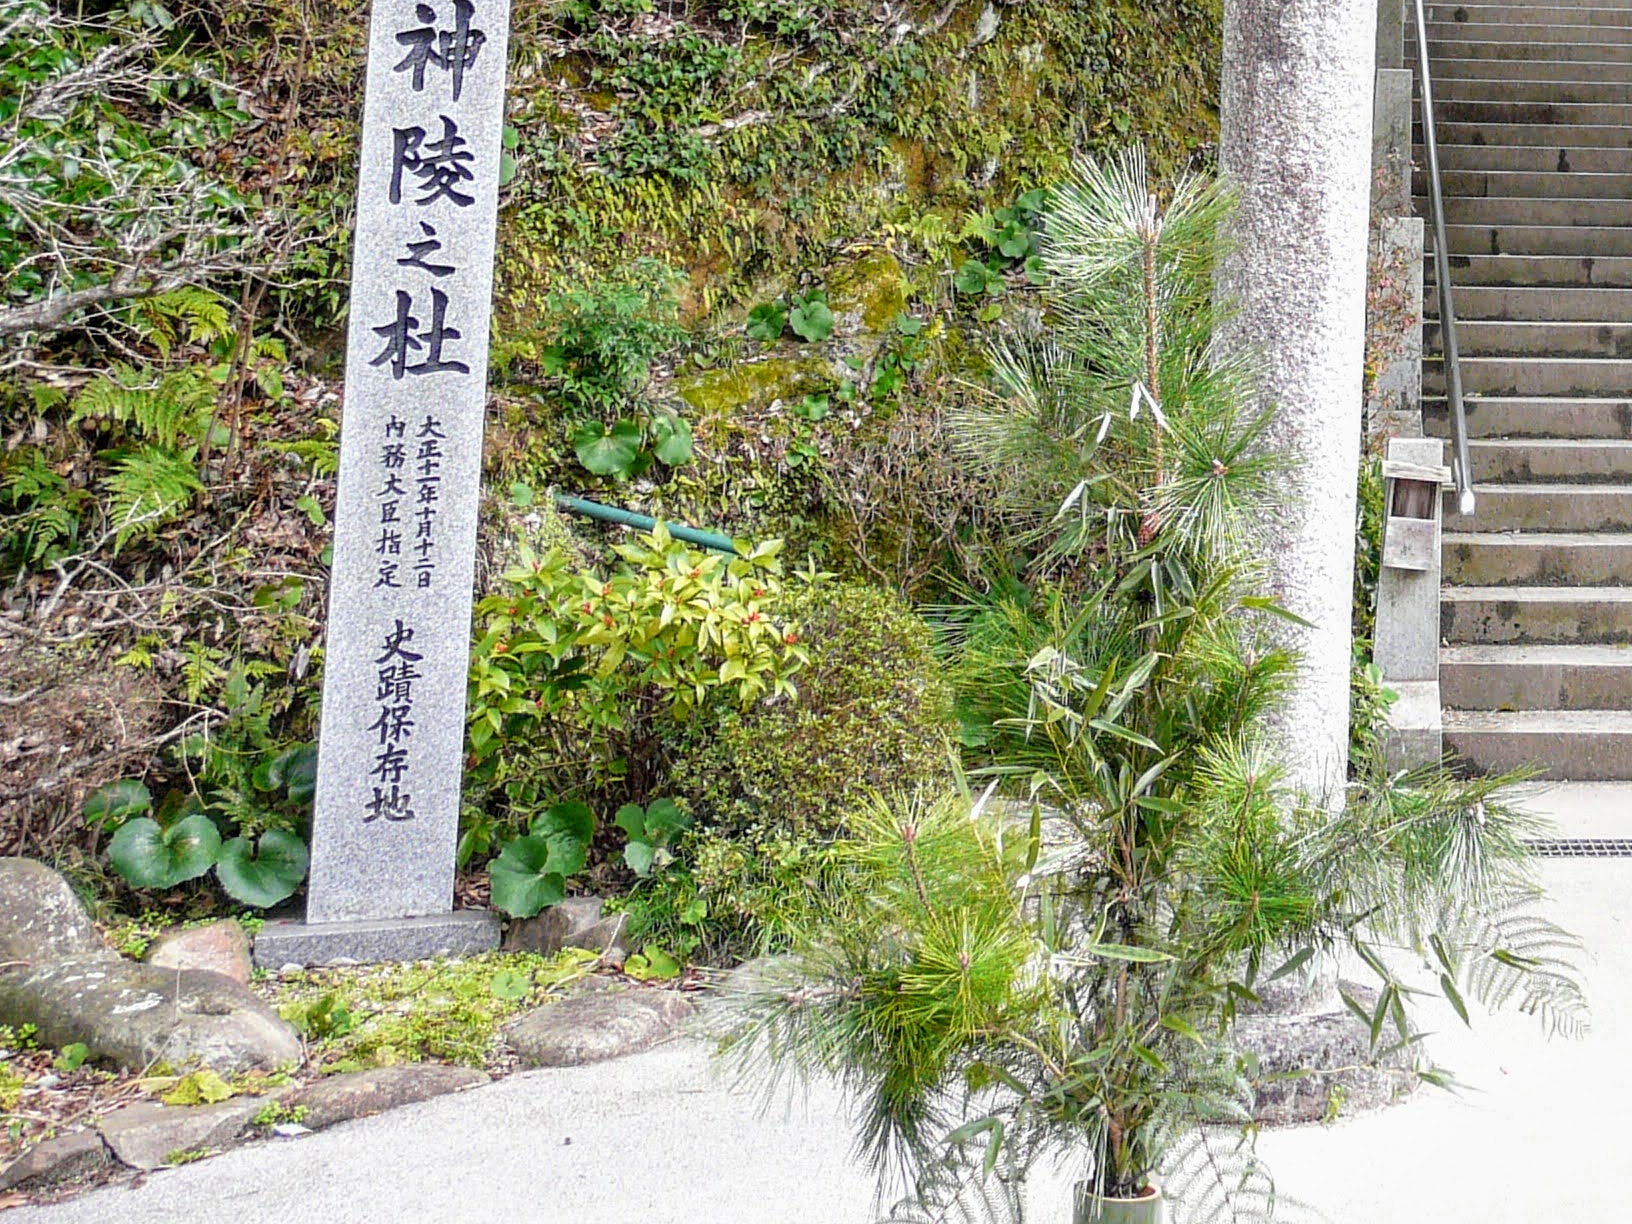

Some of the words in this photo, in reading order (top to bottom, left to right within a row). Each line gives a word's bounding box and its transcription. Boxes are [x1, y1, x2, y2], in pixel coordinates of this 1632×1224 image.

[373, 414, 408, 589] 内務大臣指定
[415, 415, 447, 589] 大正十一年十月十二日
[363, 619, 423, 824] 史蹟保存地
